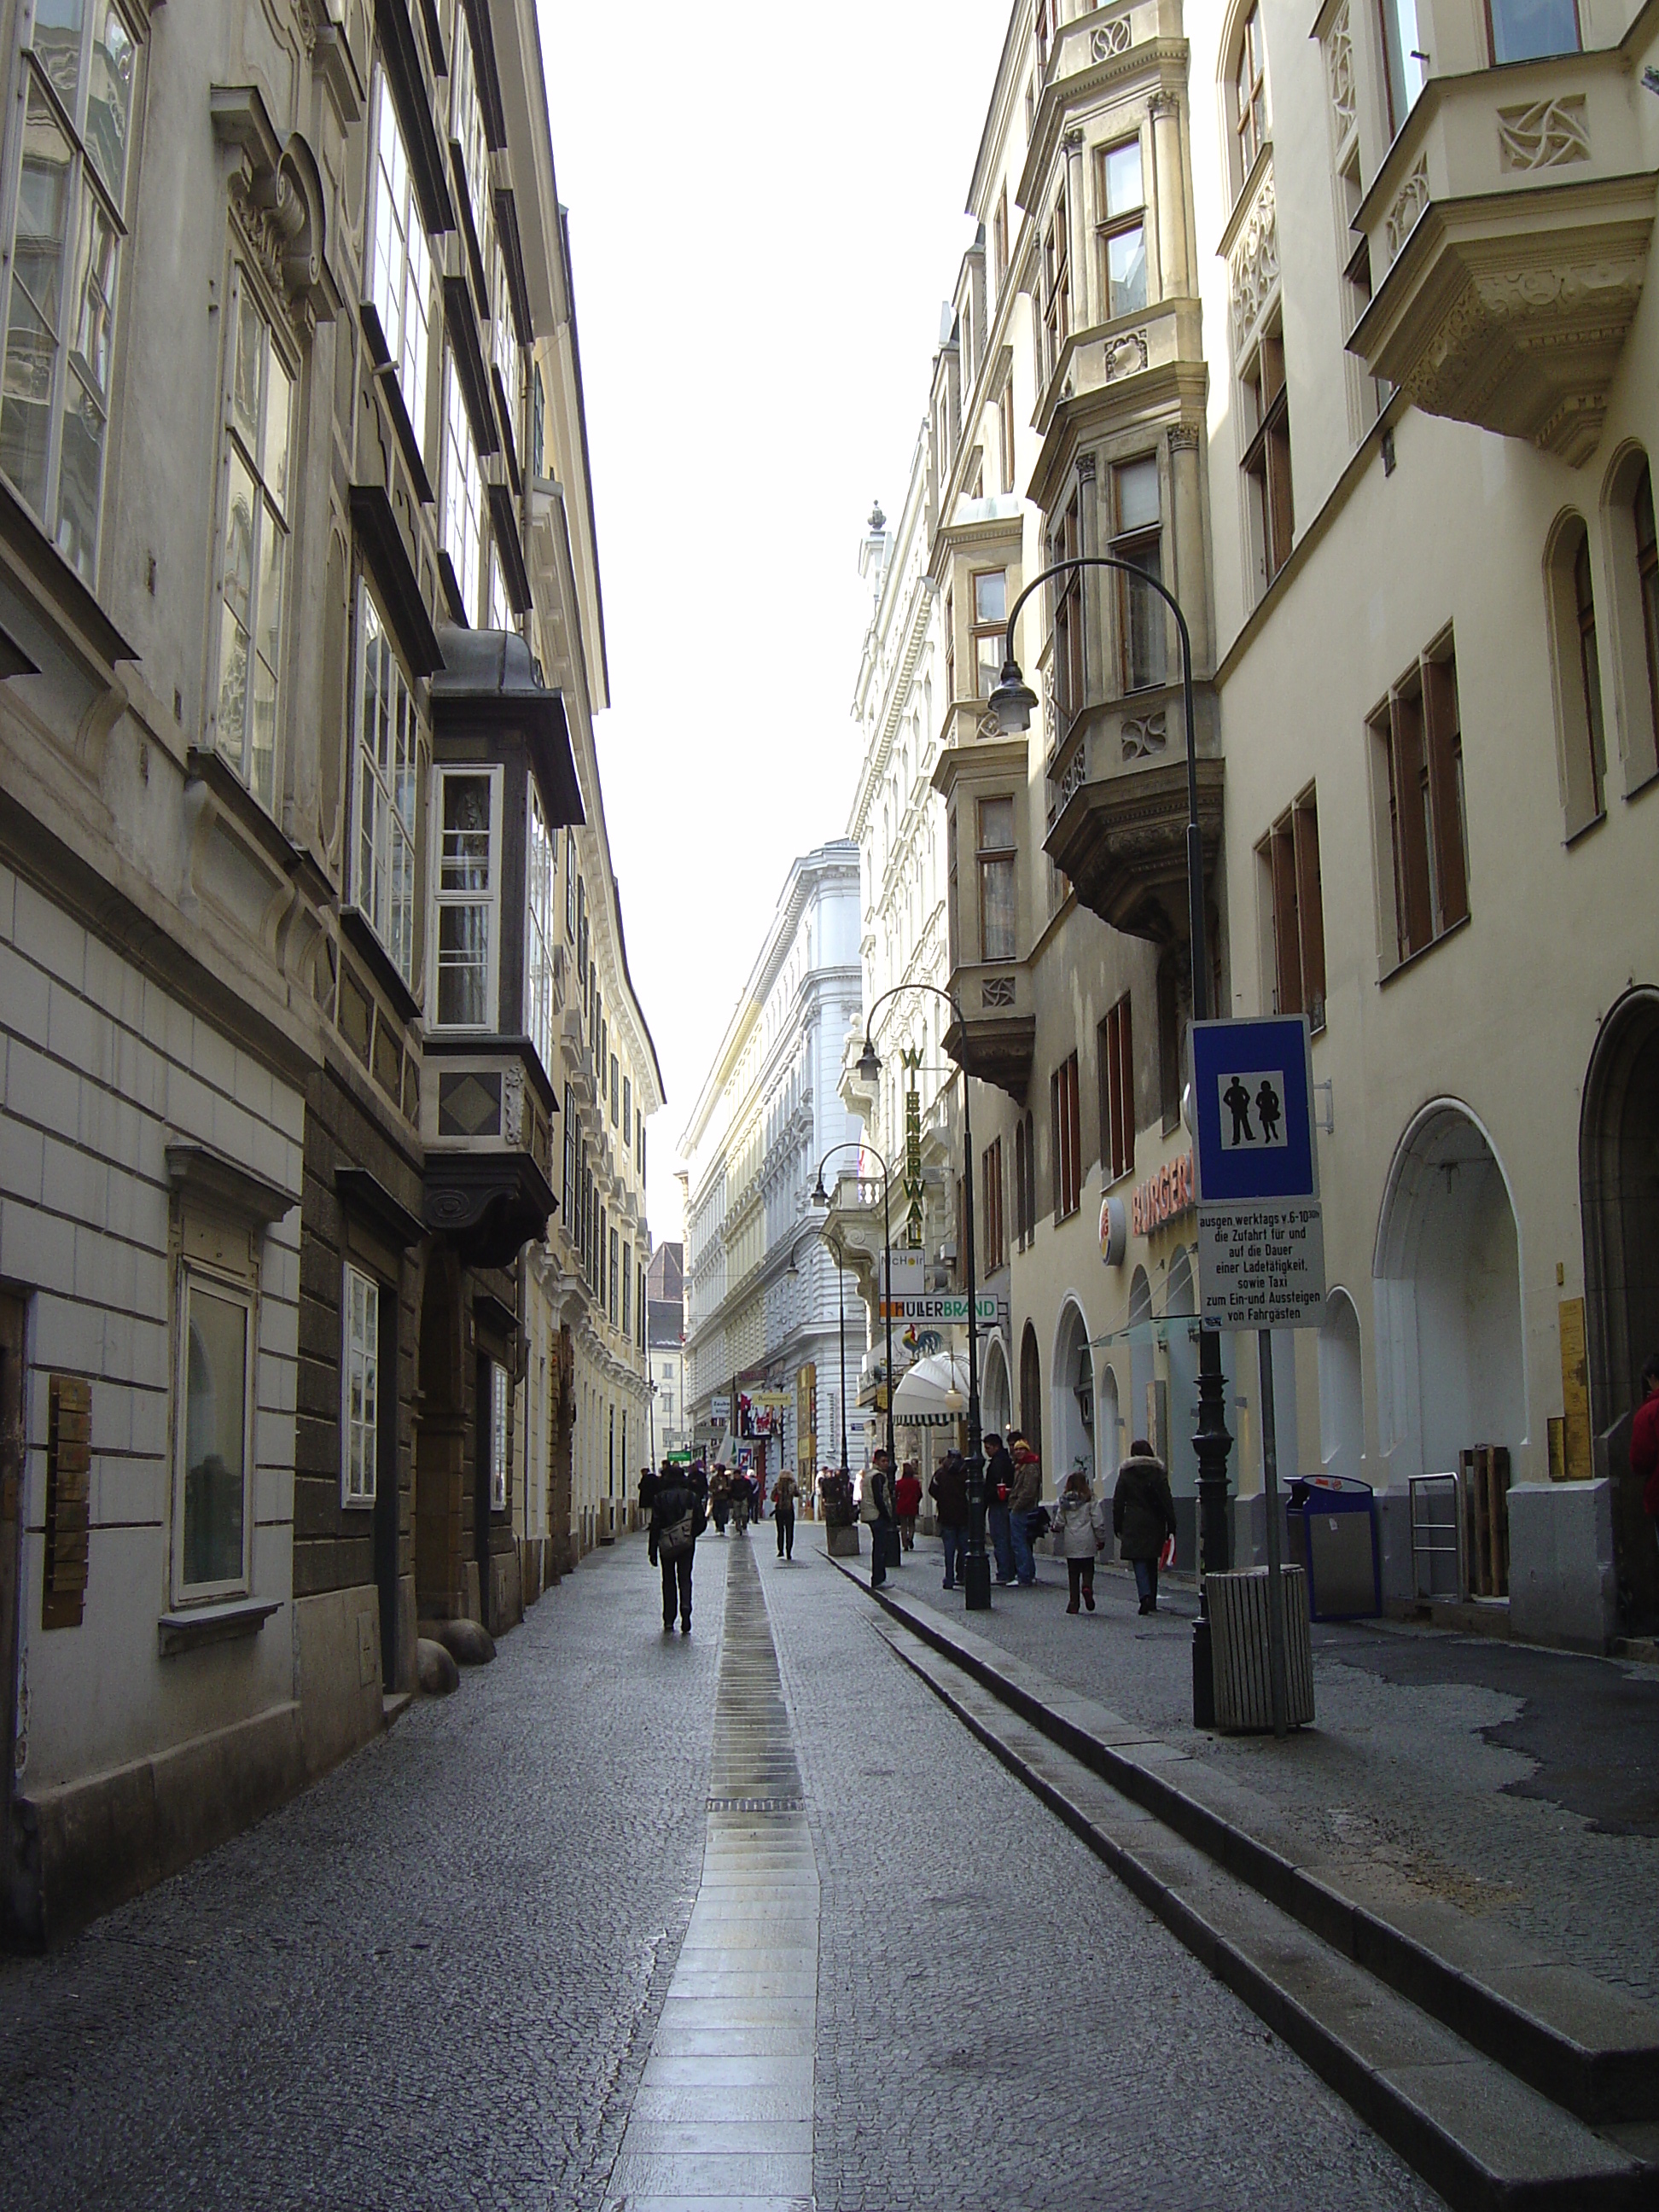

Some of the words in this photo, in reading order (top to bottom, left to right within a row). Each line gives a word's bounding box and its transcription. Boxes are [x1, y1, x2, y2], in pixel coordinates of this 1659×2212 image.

[899, 1048, 926, 1249] WIENERWAL
[1132, 1153, 1189, 1237] BURGER
[1235, 1213, 1279, 1227] werktags
[1214, 1230, 1229, 1243] die
[1232, 1229, 1267, 1242] Zufahrt
[1271, 1228, 1285, 1240] für
[1289, 1226, 1307, 1239] und
[1229, 1245, 1244, 1258] auf
[1248, 1244, 1261, 1257] die
[1265, 1243, 1293, 1256] Dauer
[1215, 1261, 1240, 1274] einer
[1237, 1276, 1265, 1289] sowie
[1268, 1275, 1288, 1288] Taxi
[1206, 1296, 1226, 1307] zum
[1268, 1290, 1320, 1306] Aussteigen
[1227, 1311, 1245, 1322] von
[1248, 1307, 1301, 1323] Fahrgästen
